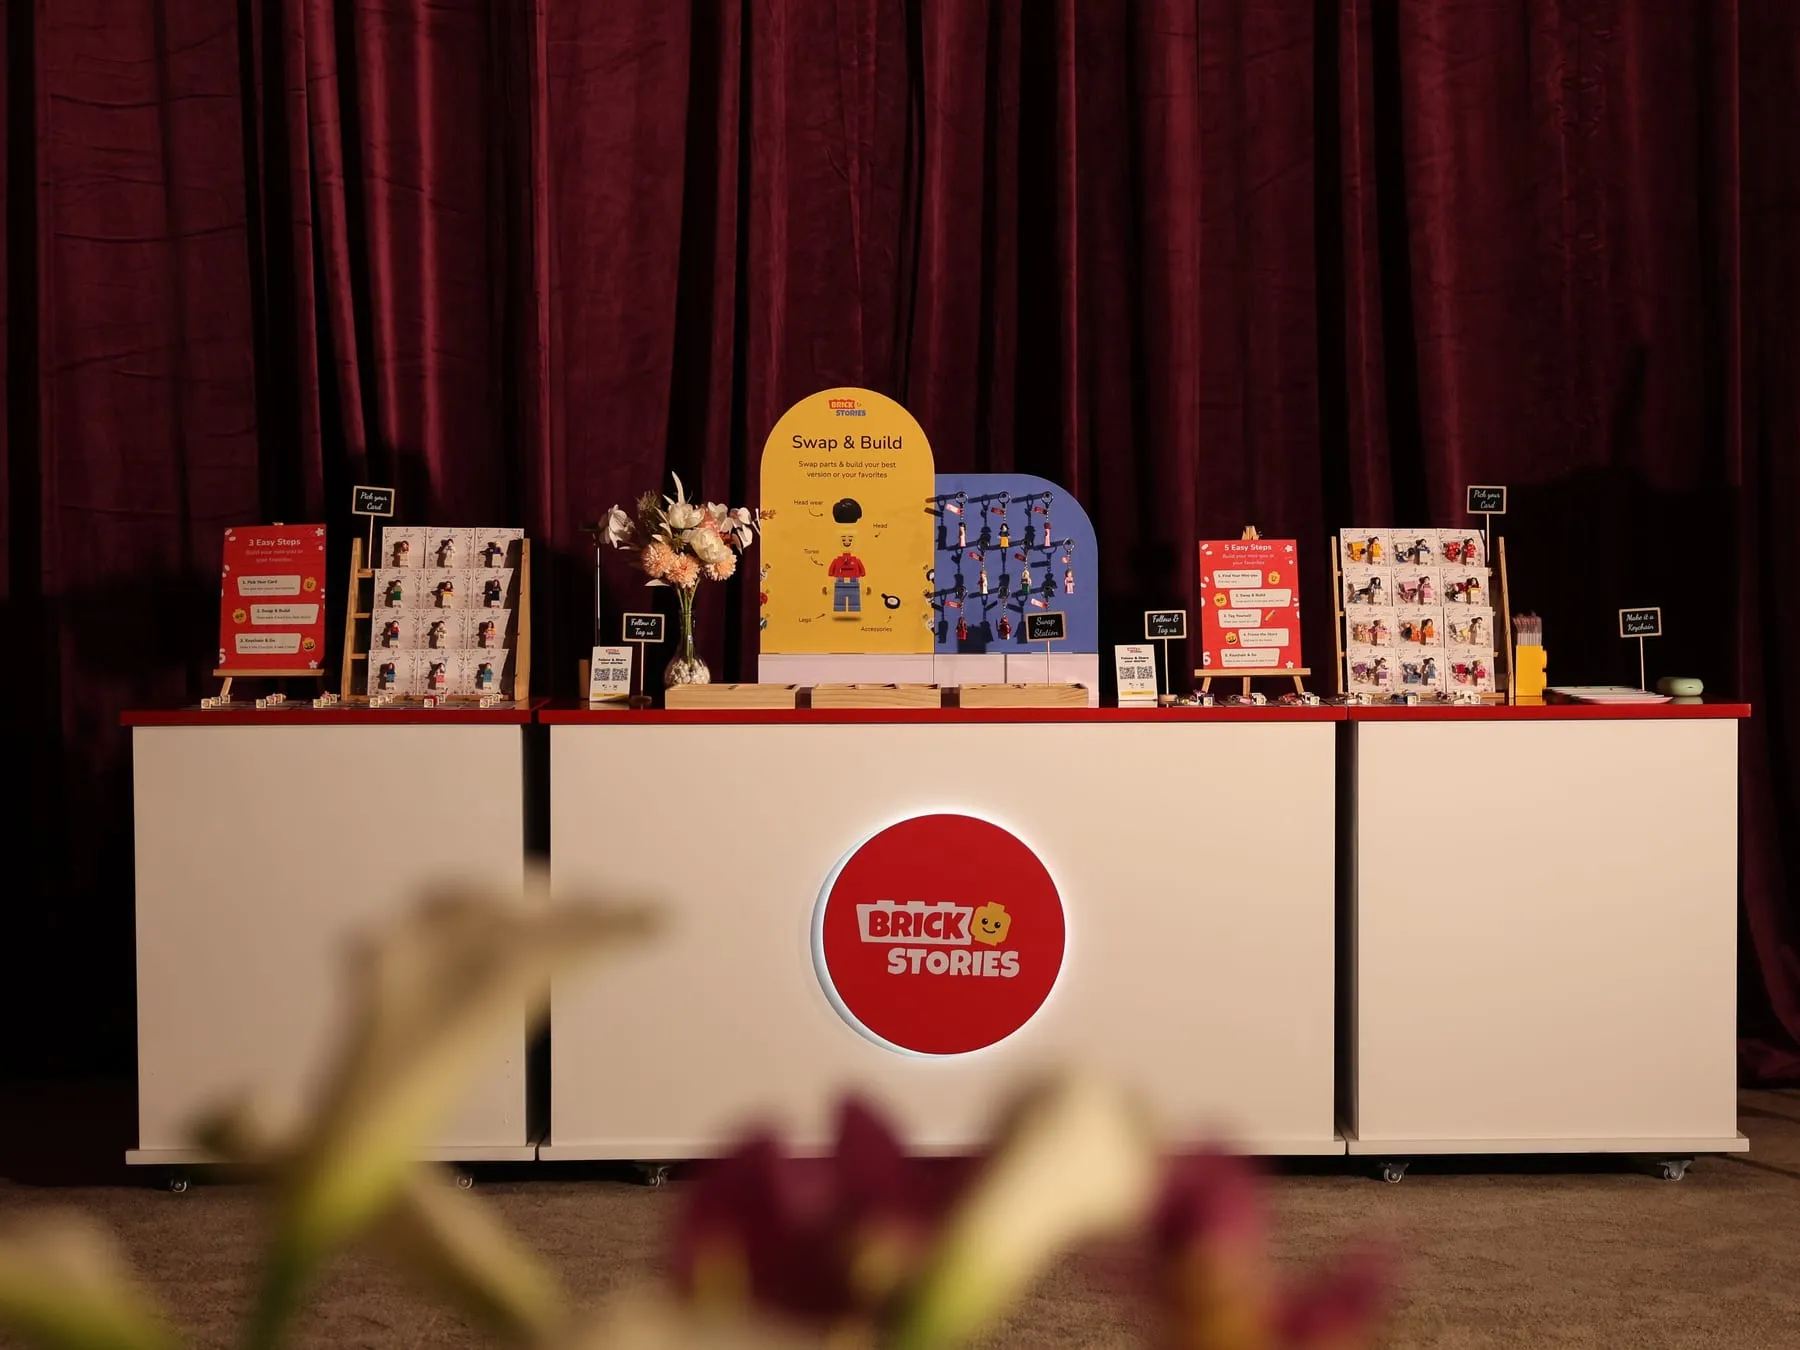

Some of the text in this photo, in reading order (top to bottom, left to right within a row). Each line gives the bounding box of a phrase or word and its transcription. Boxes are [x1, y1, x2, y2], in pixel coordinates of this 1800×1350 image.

[831, 400, 854, 409] BRICK
[792, 435, 902, 452] Swap & Build
[798, 460, 818, 468] Swap
[360, 491, 374, 500] Pick
[1474, 490, 1500, 500] Pick your
[366, 502, 383, 510] Card
[1480, 500, 1496, 509] Card
[248, 538, 301, 548] 3 Easy Steps
[1251, 544, 1272, 552] Steps
[630, 618, 656, 626] Follow &
[1036, 616, 1056, 626] Swap
[1152, 614, 1180, 623] Follow &
[1157, 625, 1168, 635] Tag
[1628, 622, 1654, 632] Keychain
[635, 628, 646, 637] Tag
[1034, 628, 1058, 638] Station
[868, 910, 966, 940] BRICK
[887, 947, 1020, 978] STORIES
